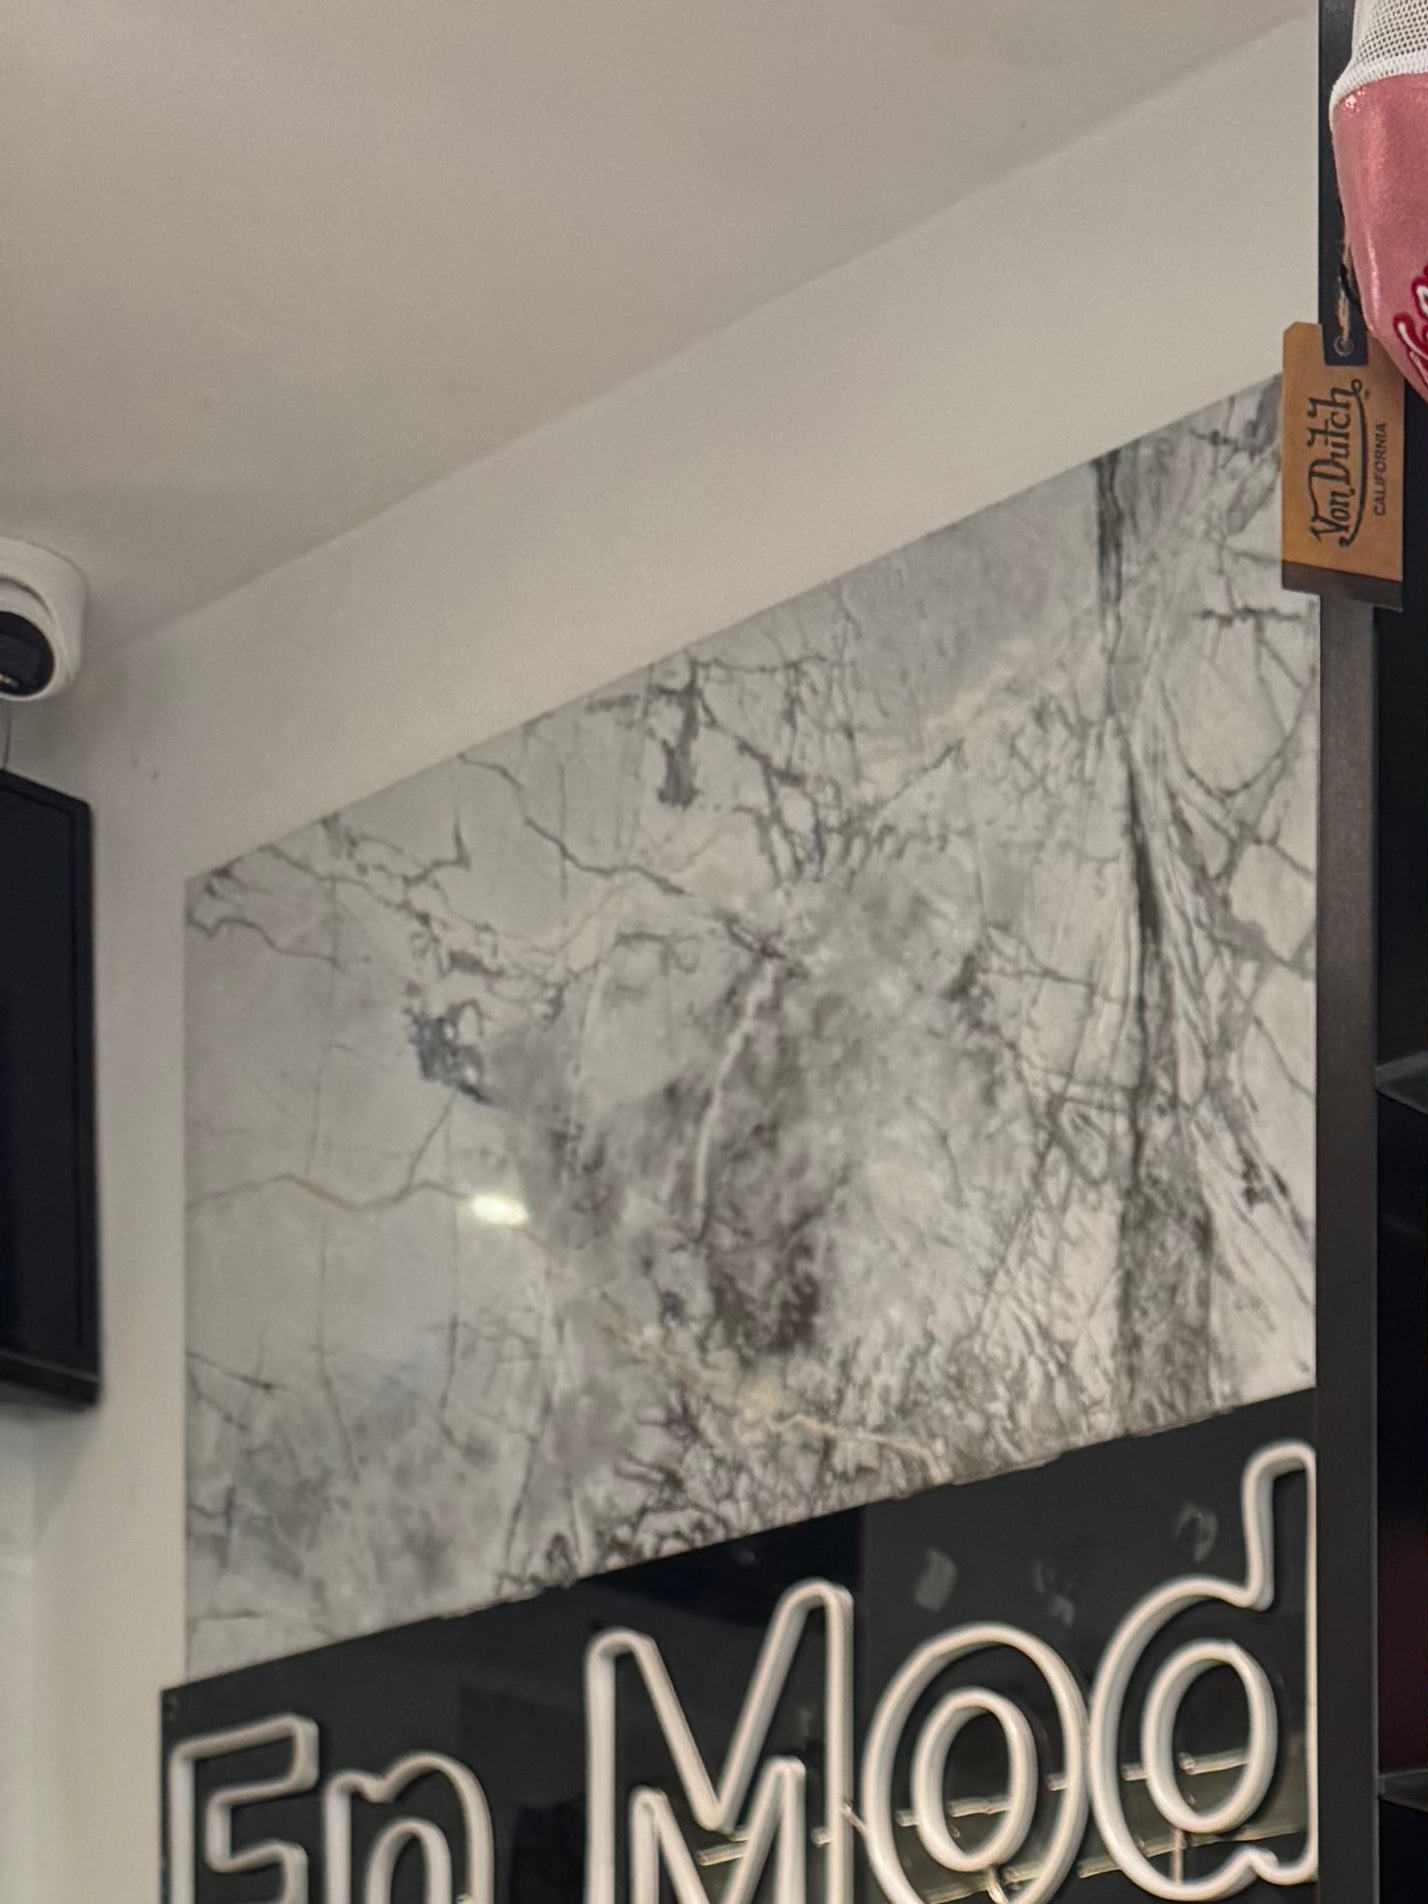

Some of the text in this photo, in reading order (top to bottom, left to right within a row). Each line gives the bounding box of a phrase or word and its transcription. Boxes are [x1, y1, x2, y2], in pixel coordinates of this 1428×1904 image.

[1306, 378, 1364, 546] Von Dutch
[1373, 421, 1389, 517] CALIFORNIA
